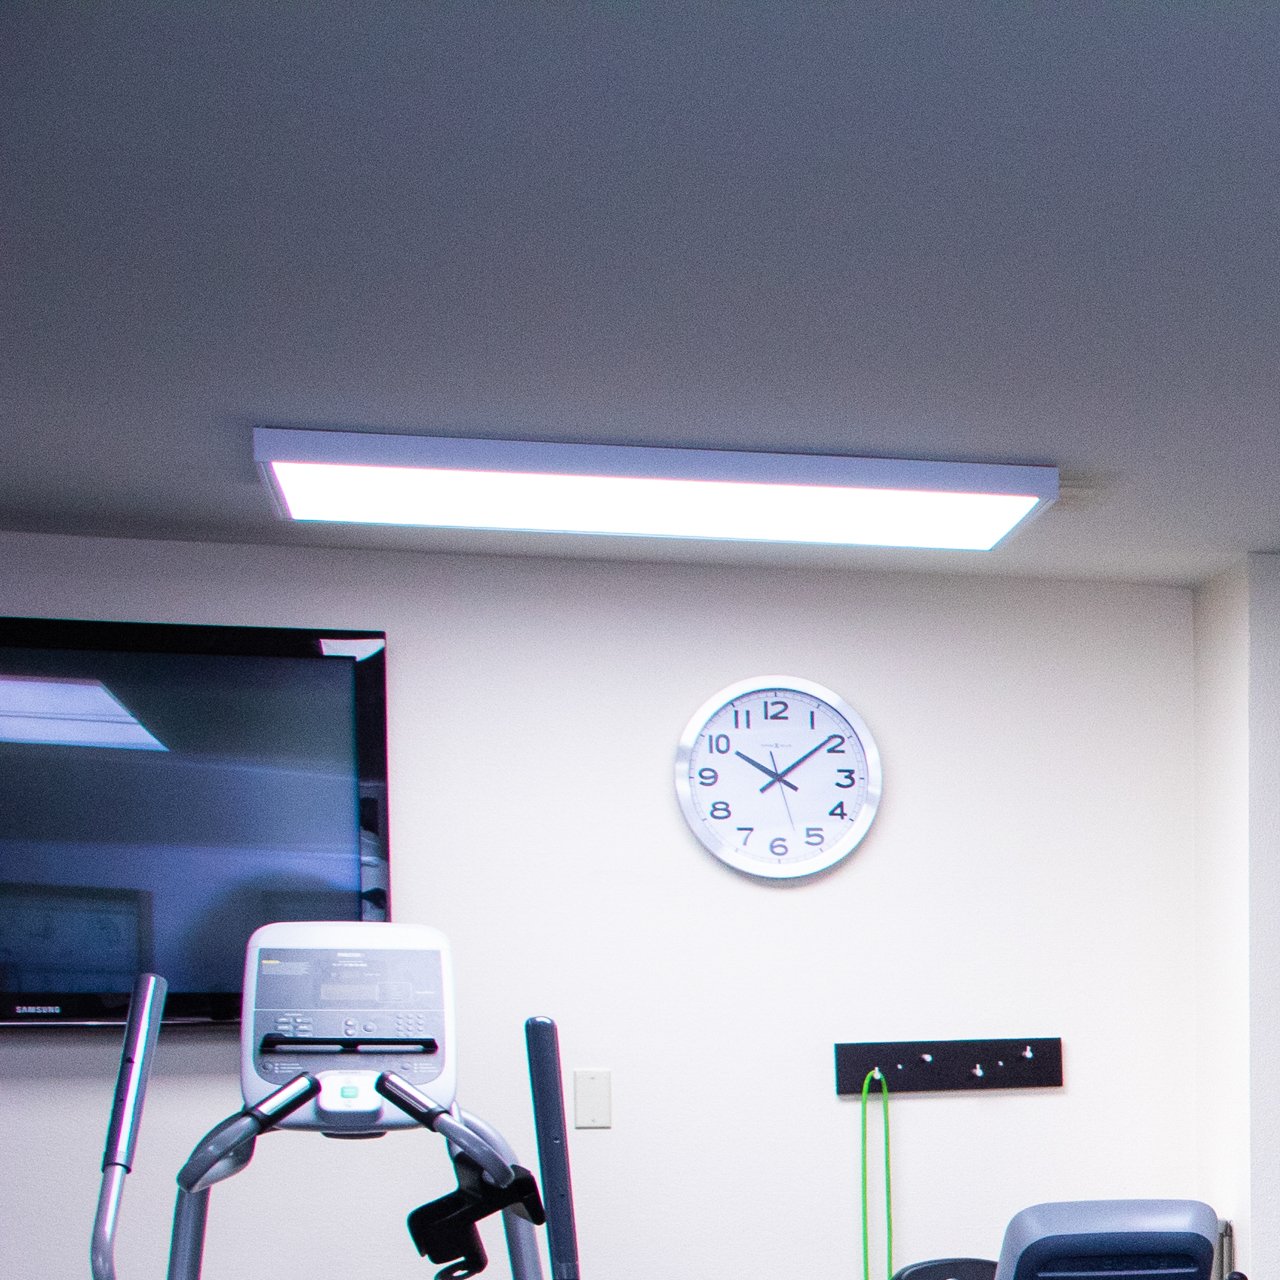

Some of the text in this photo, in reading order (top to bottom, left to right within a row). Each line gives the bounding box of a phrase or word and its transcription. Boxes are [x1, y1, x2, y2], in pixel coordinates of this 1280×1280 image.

[734, 710, 751, 729] 11
[764, 701, 789, 720] 12
[809, 711, 815, 730] 1
[708, 734, 730, 754] 10
[826, 734, 846, 753] 2
[698, 768, 718, 786] 9
[835, 769, 855, 788] 3
[710, 801, 731, 820] 8
[828, 801, 847, 820] 4
[737, 827, 754, 846] 7
[805, 828, 824, 846] 5
[769, 838, 789, 856] 6
